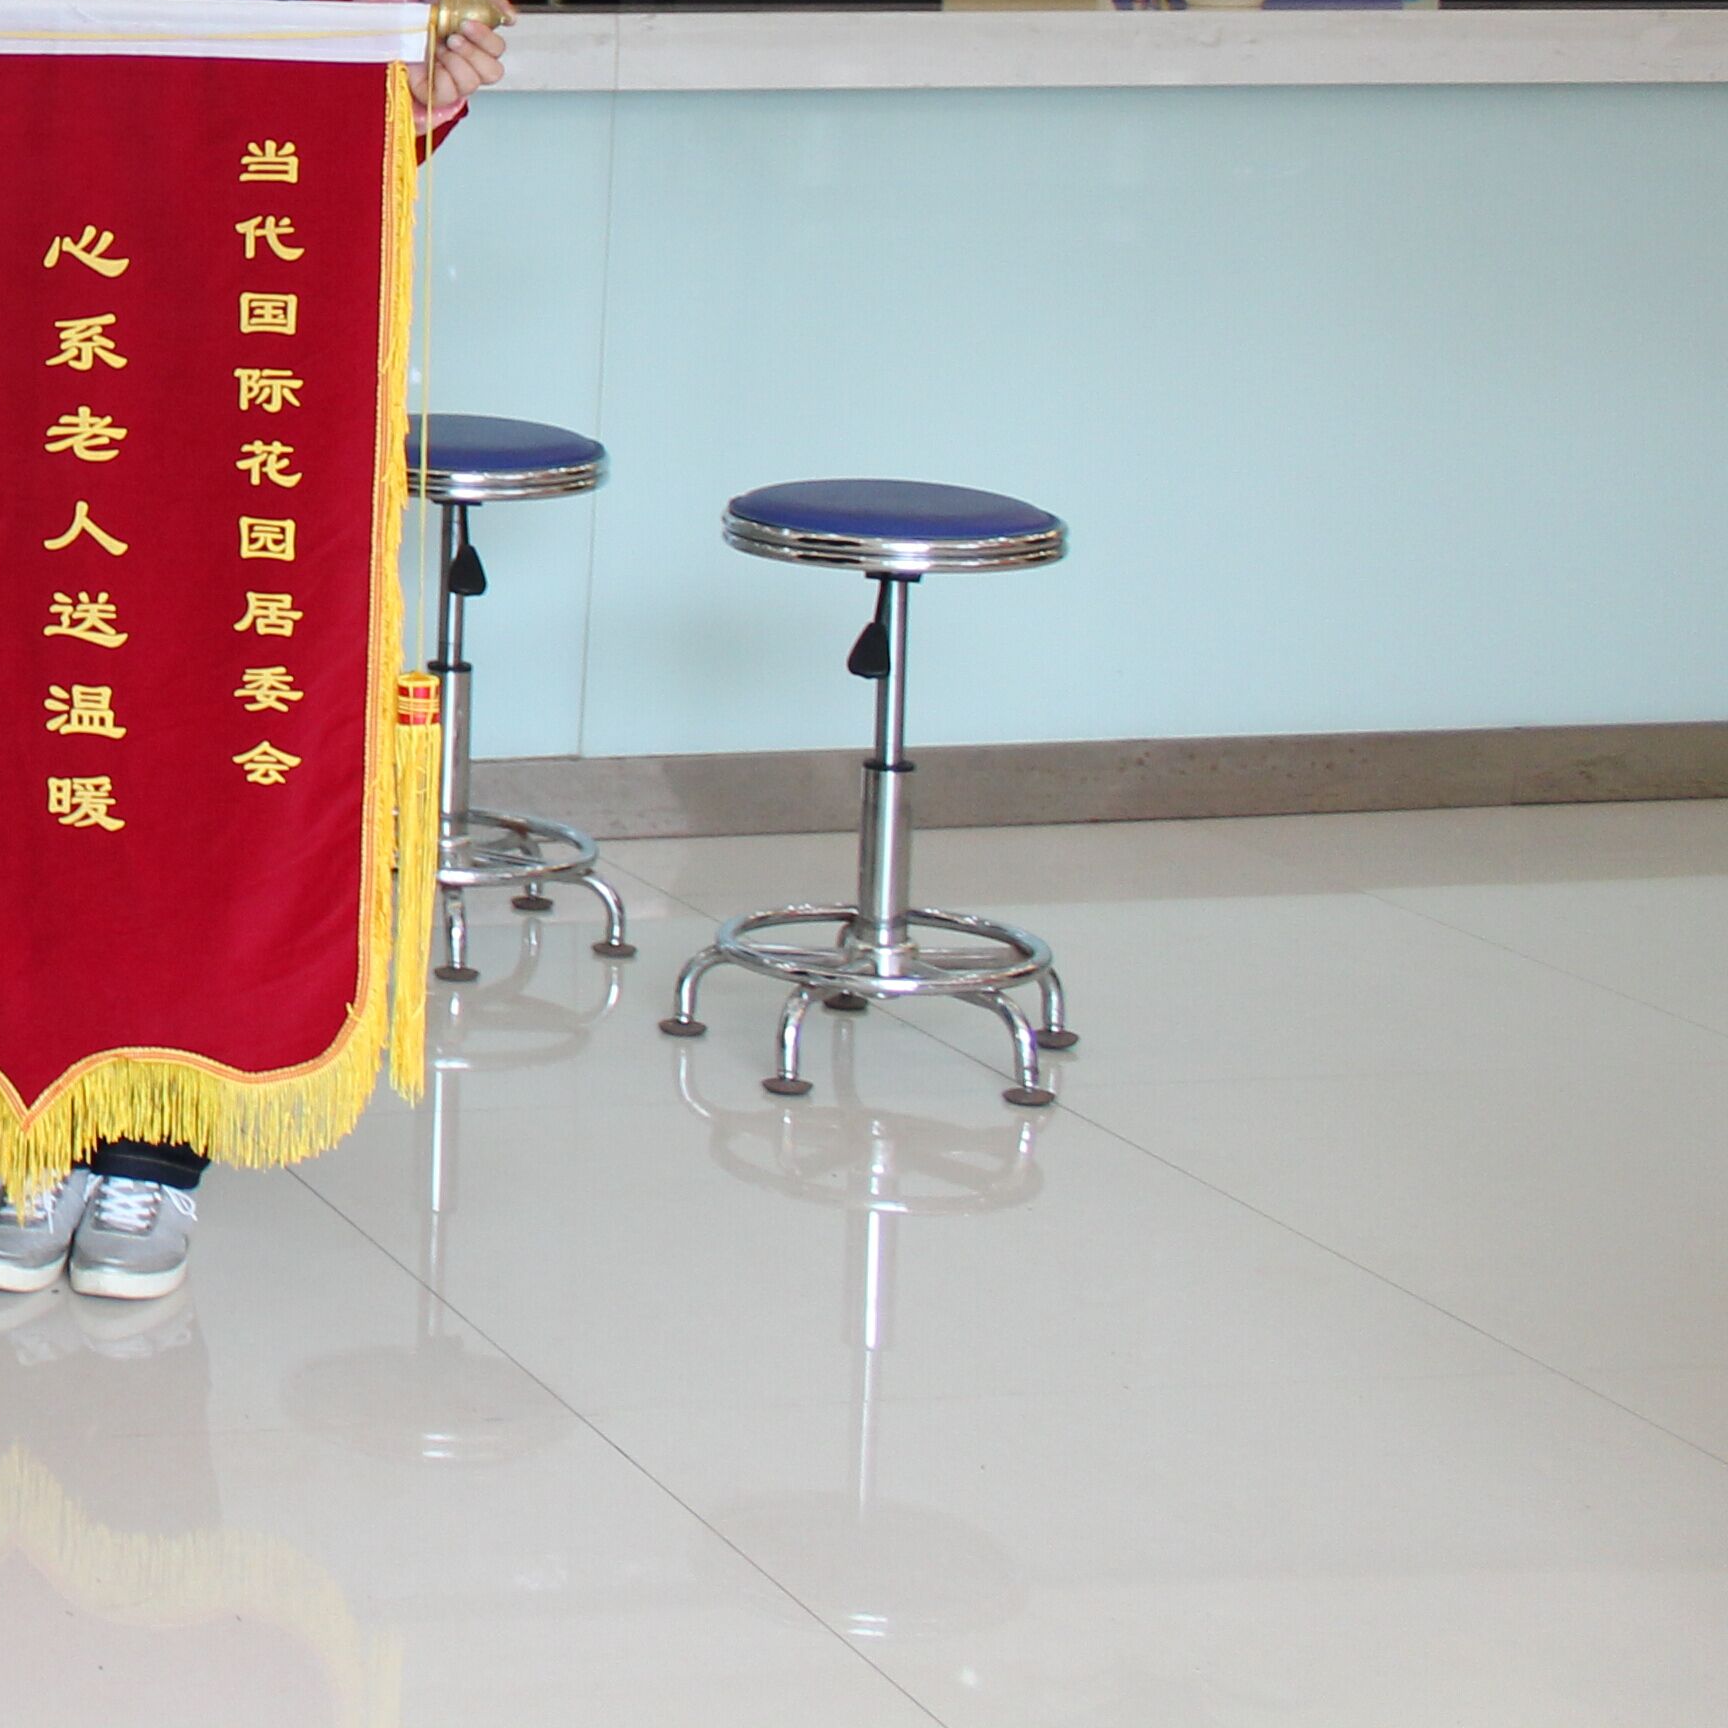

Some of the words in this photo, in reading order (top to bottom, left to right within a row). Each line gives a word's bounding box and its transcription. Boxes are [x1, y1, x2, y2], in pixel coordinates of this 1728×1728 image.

[43, 224, 129, 832] 心系老人送温暖
[234, 139, 304, 786] 当代国际花园居委会
